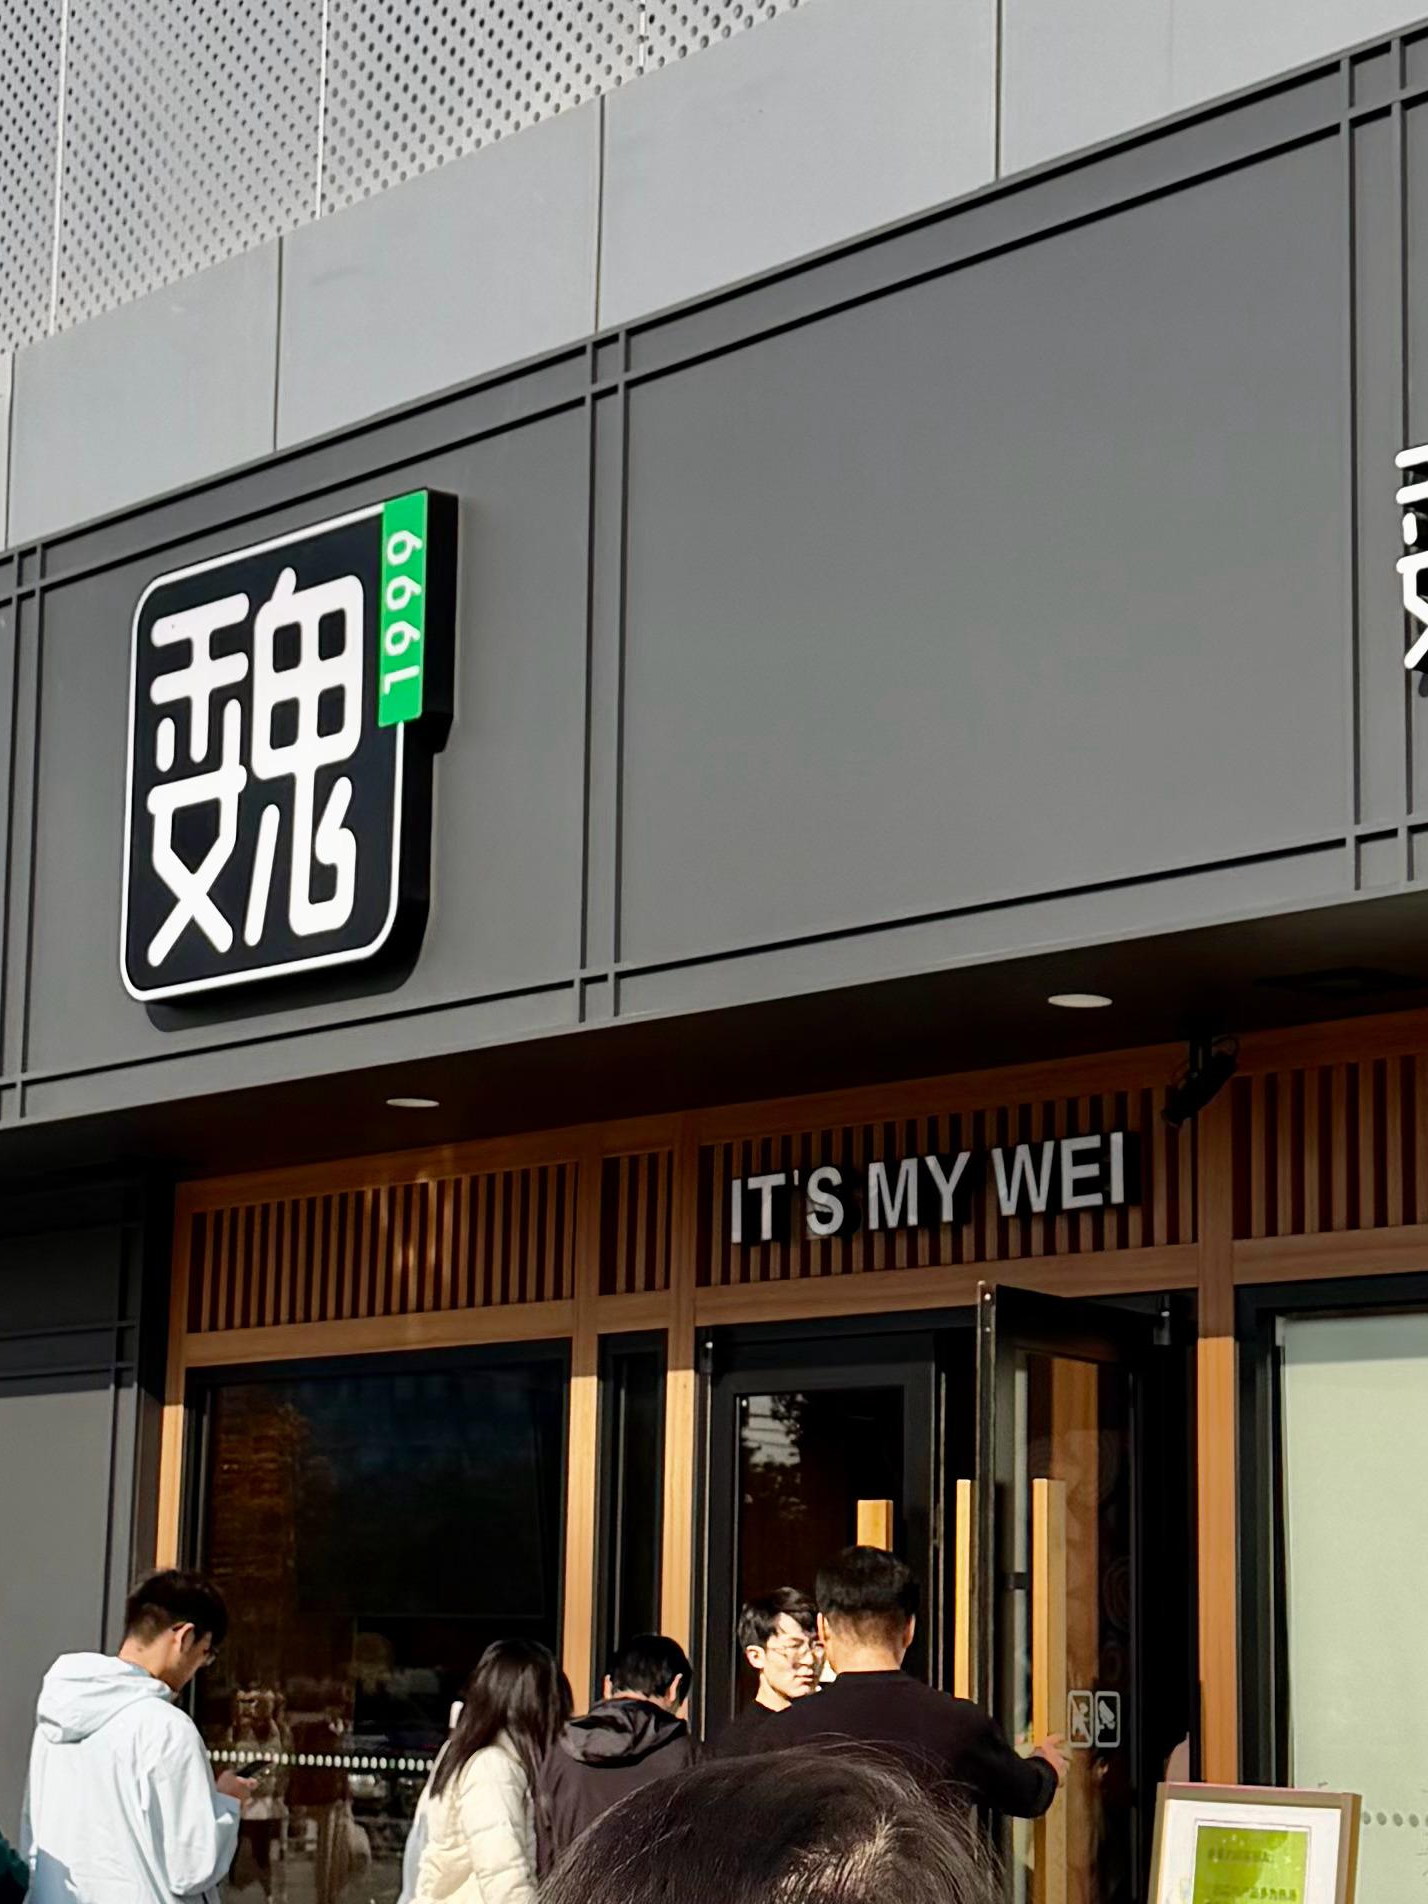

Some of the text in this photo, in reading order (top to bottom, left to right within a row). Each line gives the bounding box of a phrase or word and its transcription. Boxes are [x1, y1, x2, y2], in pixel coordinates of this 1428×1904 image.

[384, 529, 422, 695] 1999
[145, 566, 365, 967] 魏
[731, 1131, 1124, 1244] IT'S MY WEI
